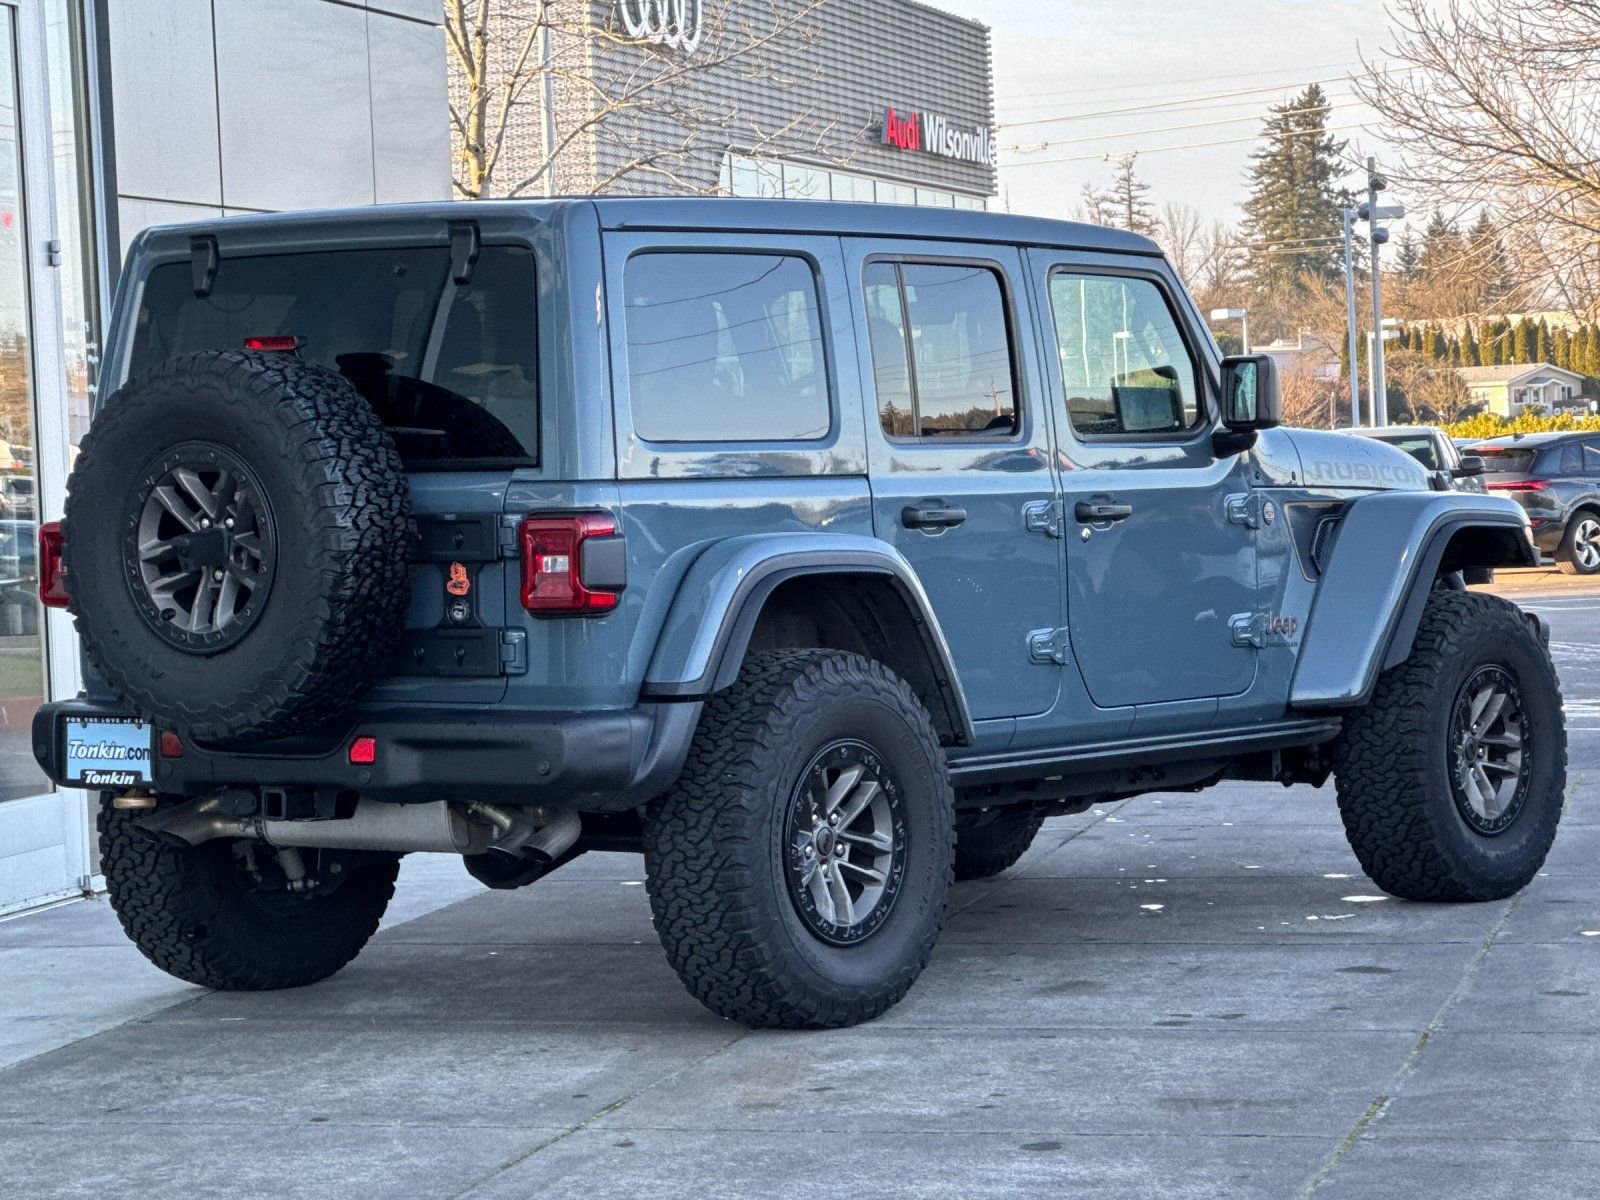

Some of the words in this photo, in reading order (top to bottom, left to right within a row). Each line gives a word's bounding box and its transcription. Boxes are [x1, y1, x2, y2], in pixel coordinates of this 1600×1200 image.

[886, 106, 920, 150] Audi
[922, 112, 997, 165] Wilsonville
[1314, 460, 1426, 487] RUBICON
[1264, 611, 1297, 639] Jeep
[84, 771, 134, 785] Tonkin
